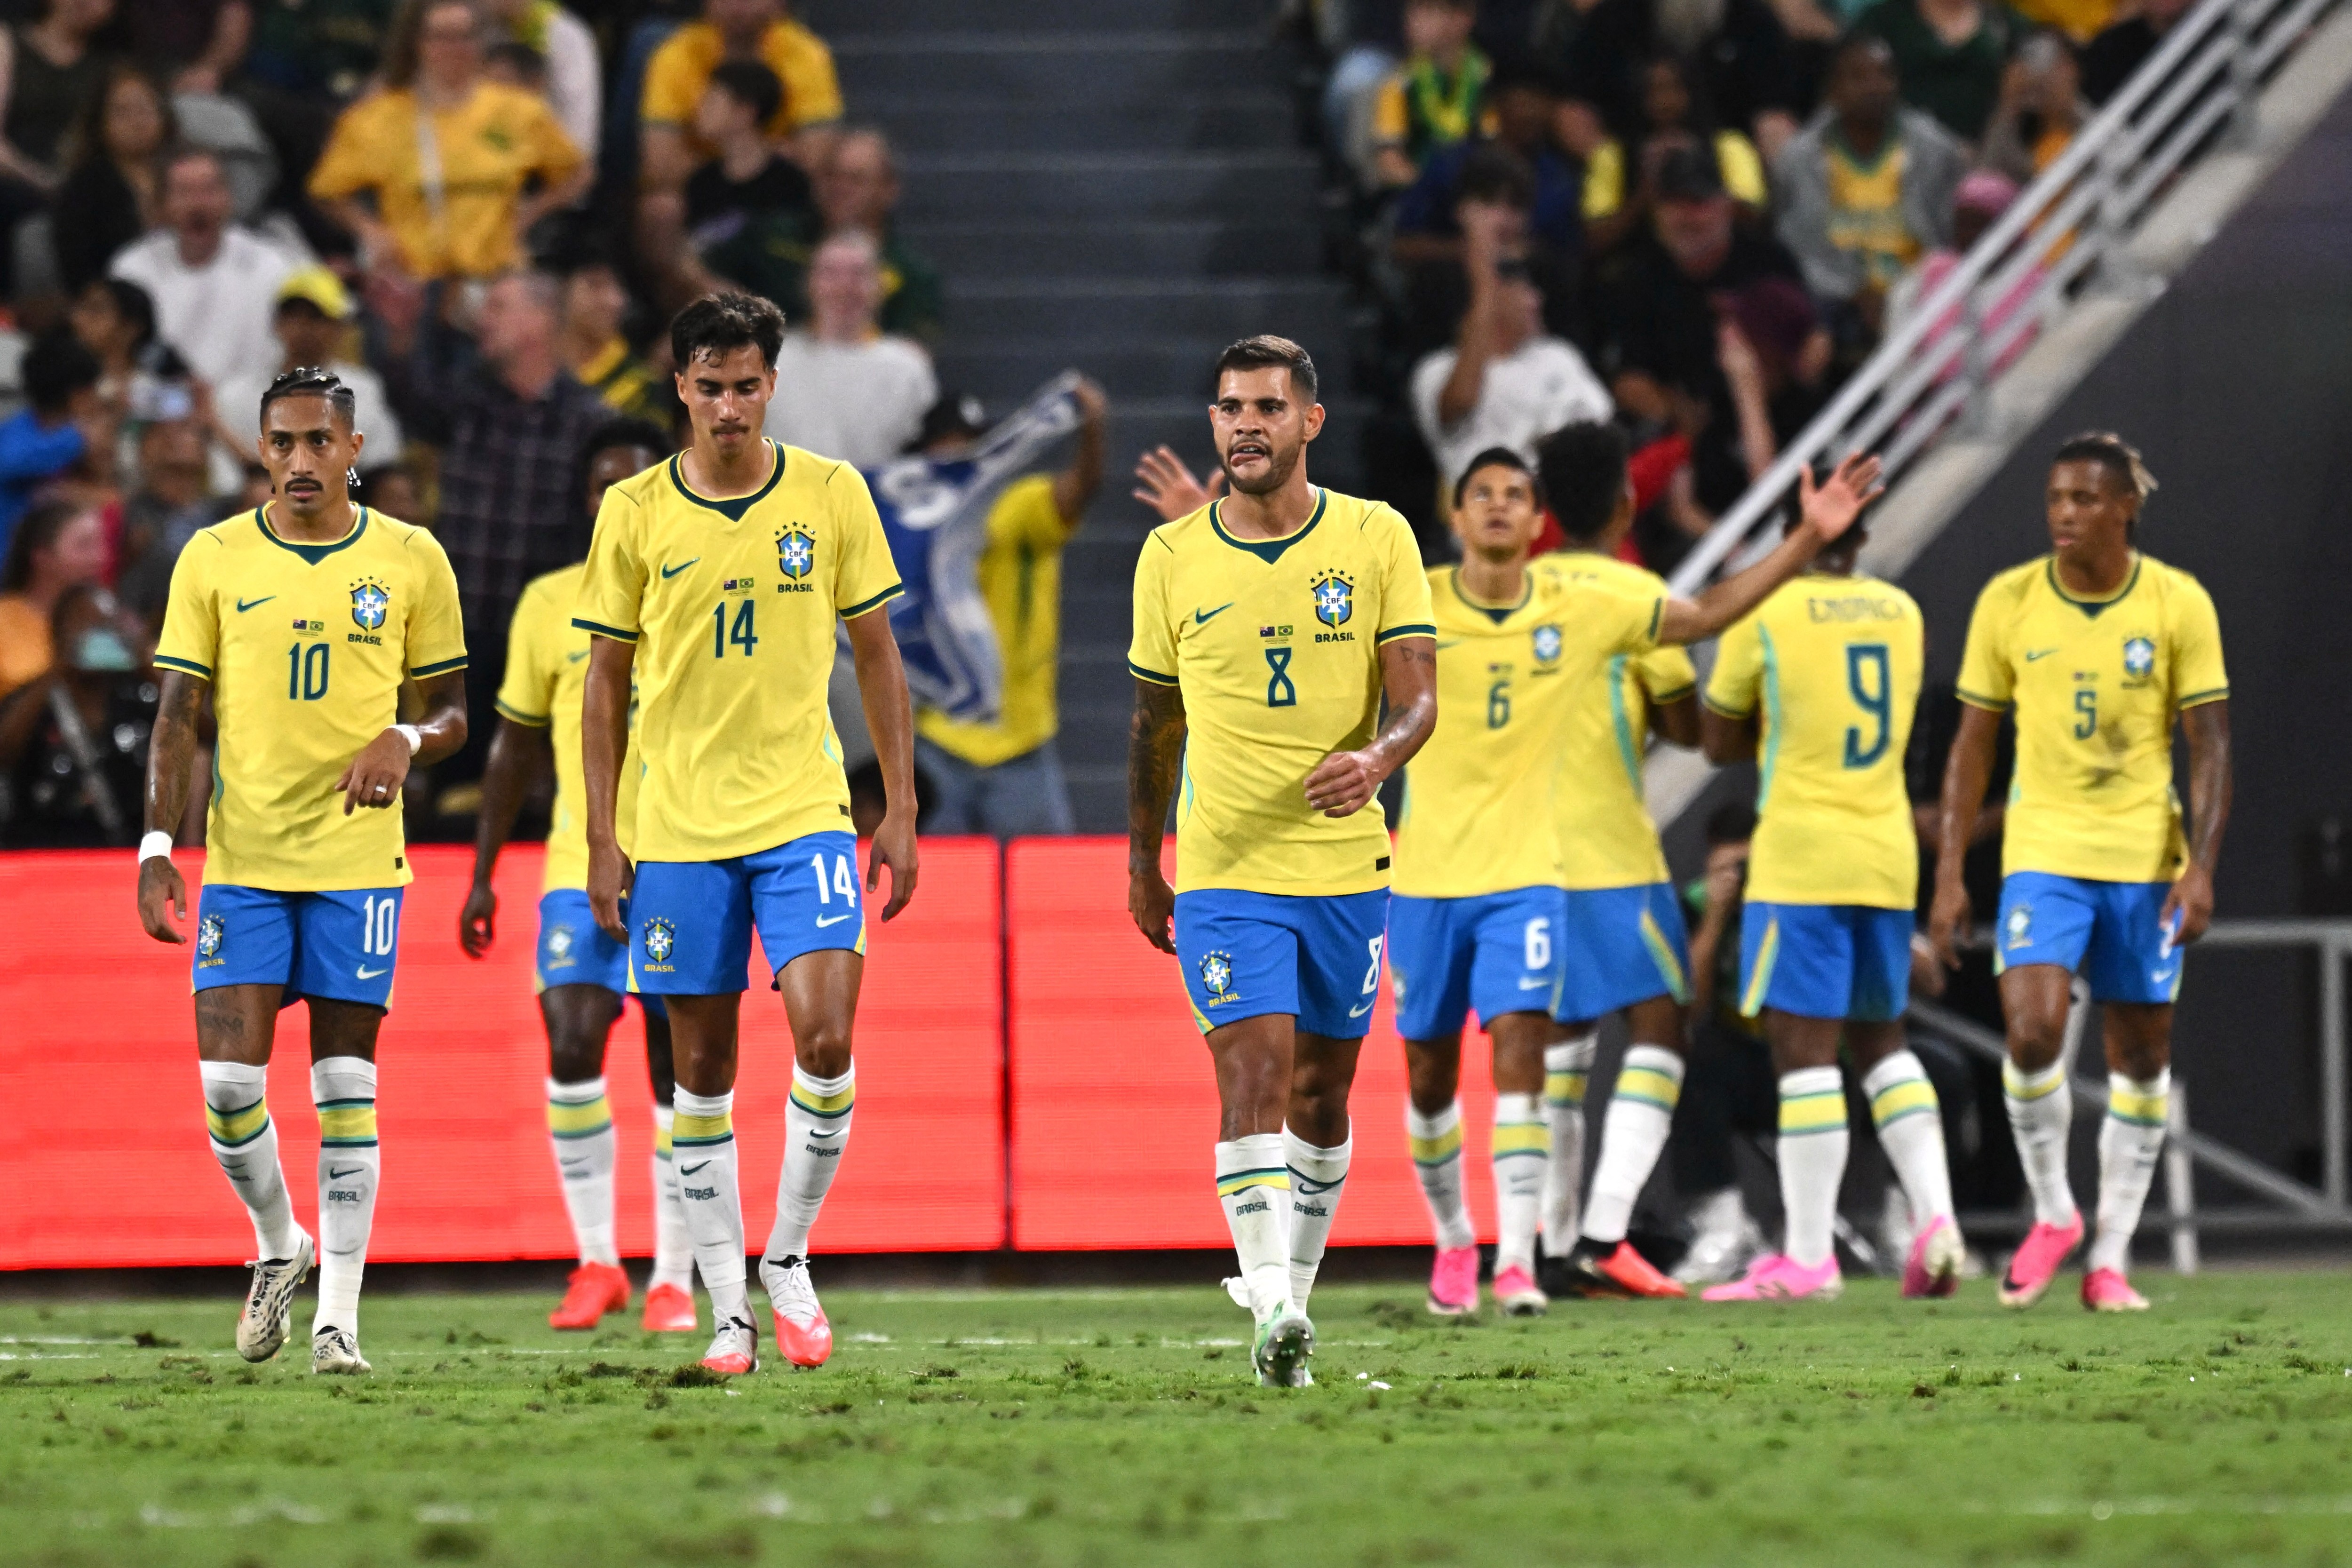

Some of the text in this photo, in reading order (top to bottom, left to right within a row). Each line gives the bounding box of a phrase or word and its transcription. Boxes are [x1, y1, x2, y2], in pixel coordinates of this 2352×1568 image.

[778, 583, 814, 593] BRASIL
[348, 633, 382, 646] BRASIL
[714, 600, 758, 658] 14
[1315, 632, 1355, 643] BRASIL
[288, 642, 330, 700] 10
[1265, 647, 1296, 707] 8
[1488, 680, 1510, 730] 6
[1843, 643, 1891, 769] 9
[2074, 691, 2097, 740] 5
[810, 853, 856, 908] 14
[363, 895, 395, 955] 10
[1525, 916, 1551, 971] 6
[644, 964, 676, 972] BRASIL
[1362, 934, 1384, 995] 8
[1208, 992, 1241, 1007] BRASIL
[805, 1144, 841, 1157] BRASIL
[328, 1191, 360, 1202] BRASIL
[684, 1186, 719, 1201] BRASIL
[1236, 1201, 1271, 1216] BRASIL
[1294, 1201, 1328, 1217] BRASIL
